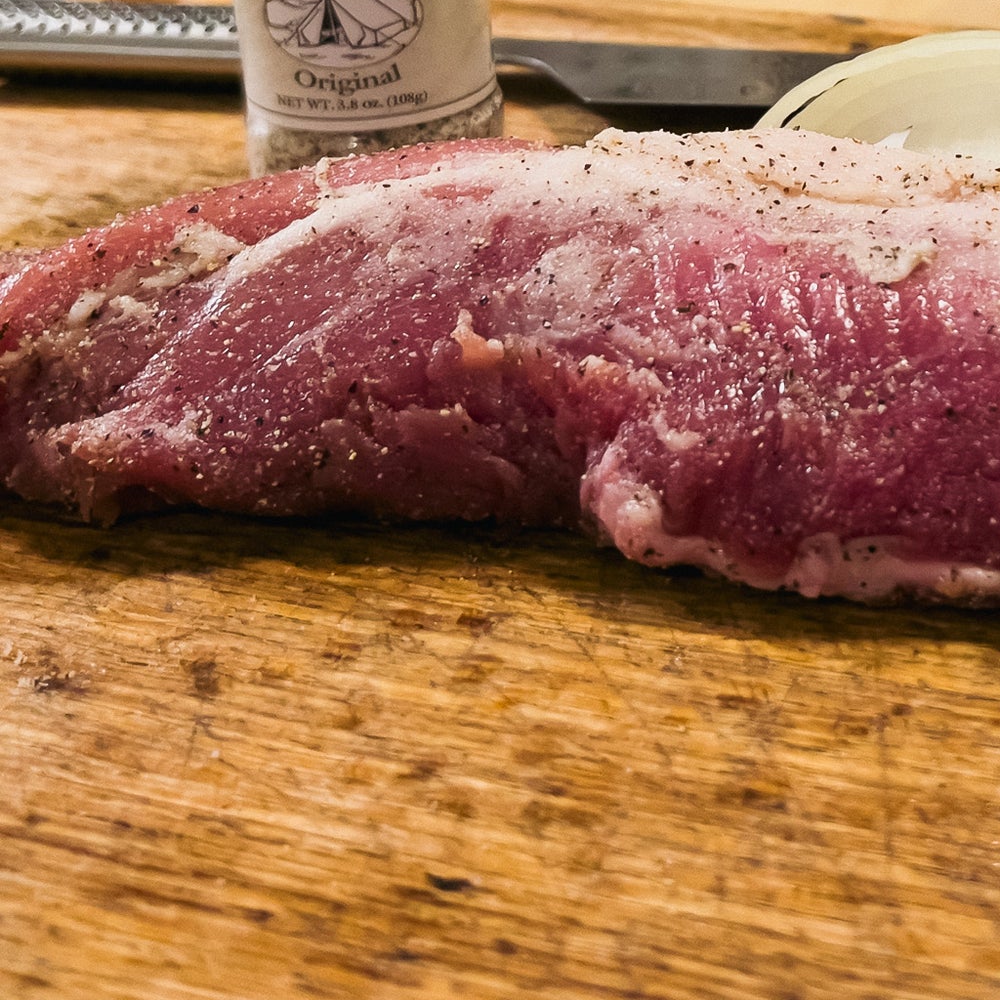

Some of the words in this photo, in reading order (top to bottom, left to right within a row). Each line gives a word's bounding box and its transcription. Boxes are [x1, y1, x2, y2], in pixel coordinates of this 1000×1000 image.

[294, 62, 402, 97] Original
[276, 93, 305, 108] NET
[306, 97, 335, 110] WT.
[336, 97, 359, 110] 3.8
[362, 99, 384, 109] oz.
[386, 90, 428, 107] (108g)
